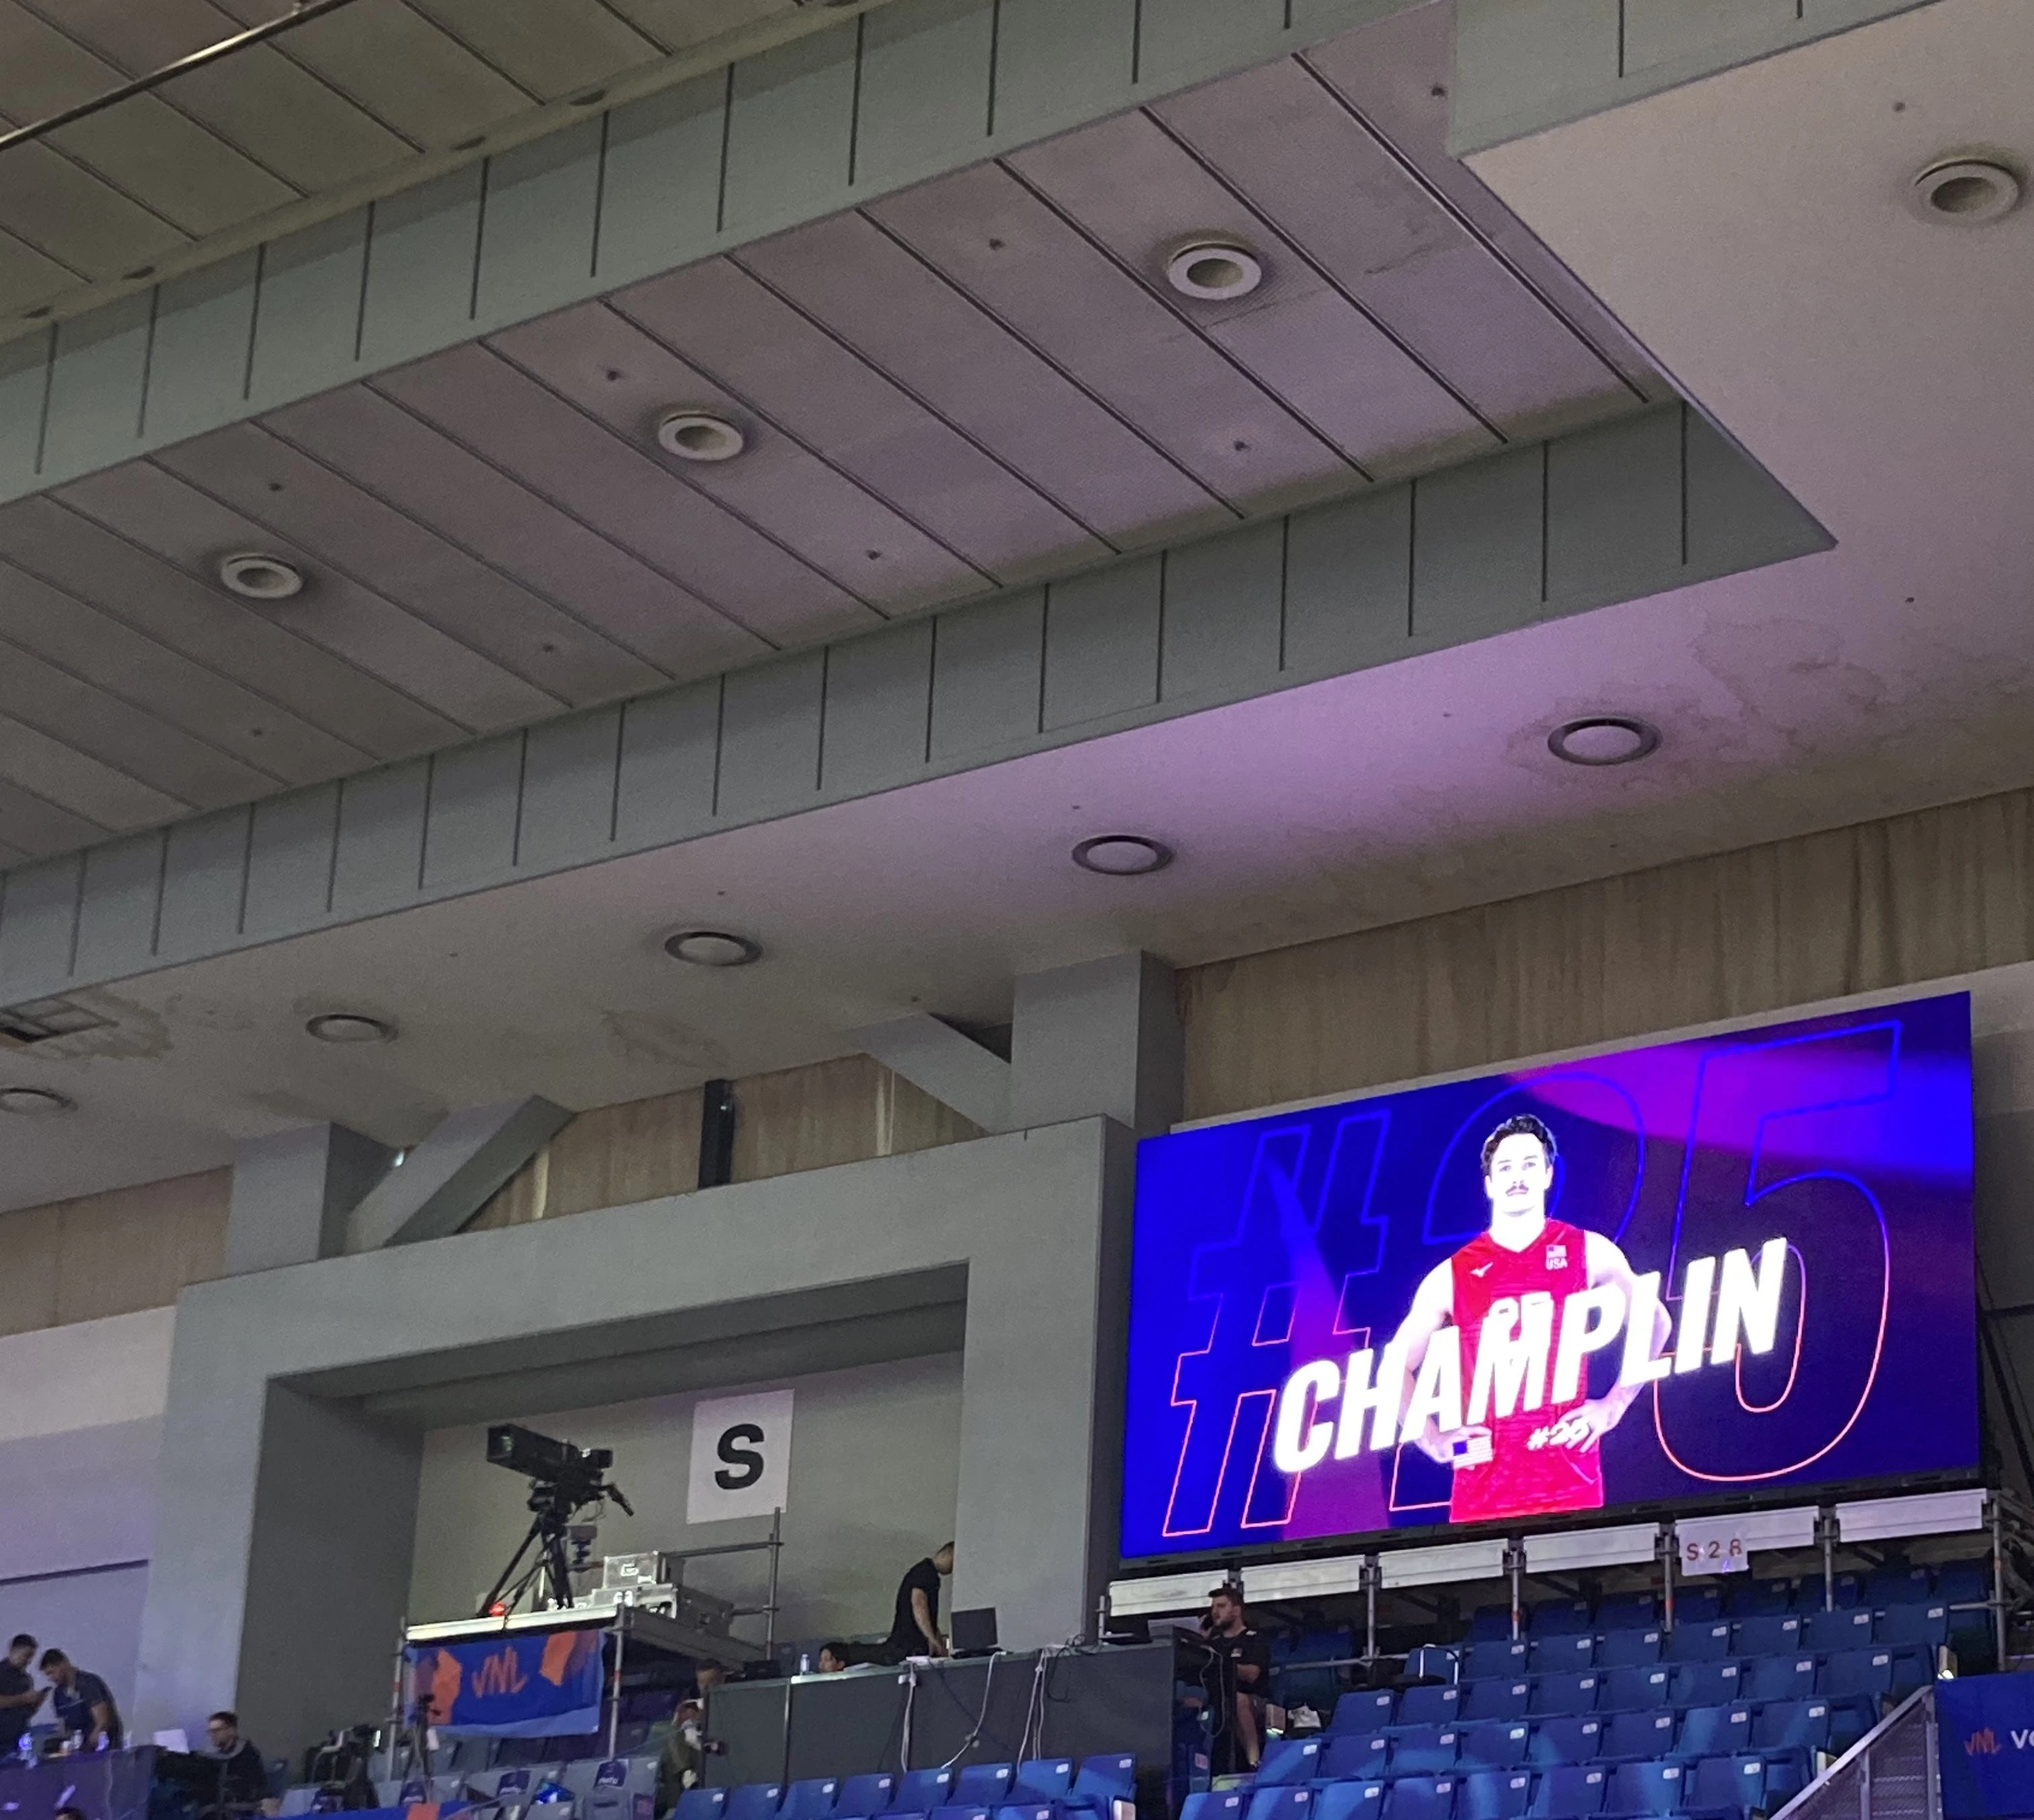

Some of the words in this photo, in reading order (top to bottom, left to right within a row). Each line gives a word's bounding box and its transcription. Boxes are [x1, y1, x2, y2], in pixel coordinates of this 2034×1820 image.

[1546, 1257, 1568, 1271] USA
[1273, 1236, 1788, 1474] CHAMPLIN
[714, 1423, 765, 1490] S
